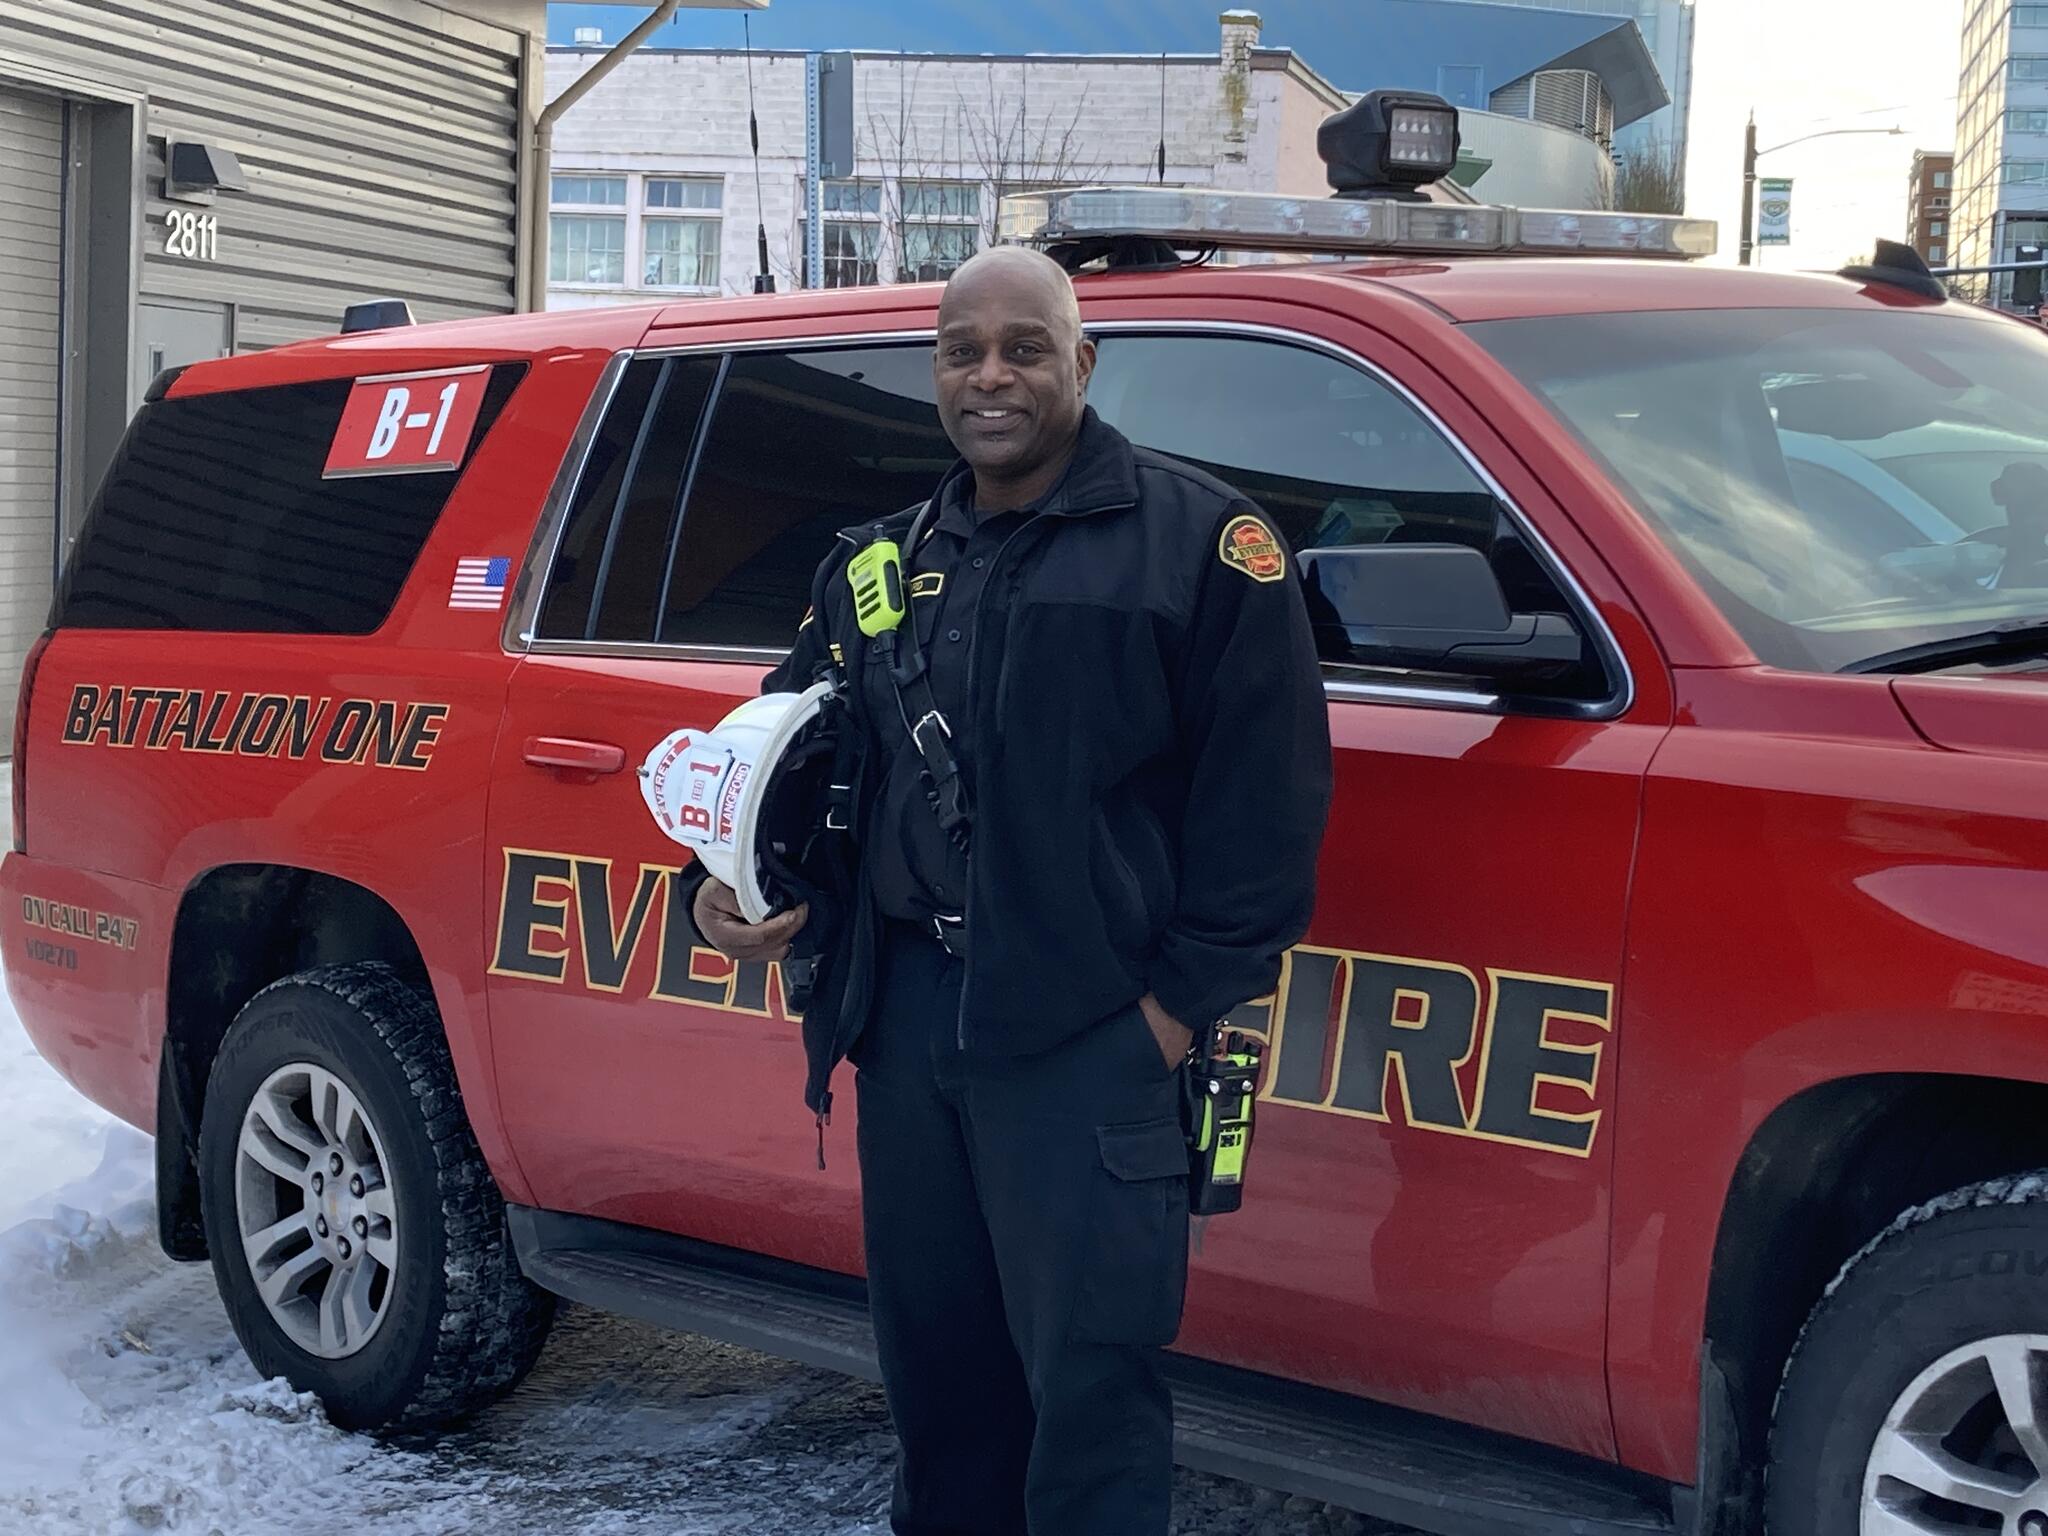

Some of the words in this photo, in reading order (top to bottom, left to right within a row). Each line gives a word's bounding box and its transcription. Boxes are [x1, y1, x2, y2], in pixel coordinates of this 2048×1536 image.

[166, 209, 217, 260] 2811
[365, 382, 460, 460] B-1
[62, 684, 332, 759] BATTALION
[320, 698, 450, 771] ONE
[655, 748, 677, 815] EVERETT
[690, 762, 722, 778] 1
[722, 764, 751, 828] LANGFORD
[680, 804, 711, 833] B
[22, 895, 46, 928] ON
[47, 901, 95, 940] CALL
[1222, 943, 1614, 1159] IRE
